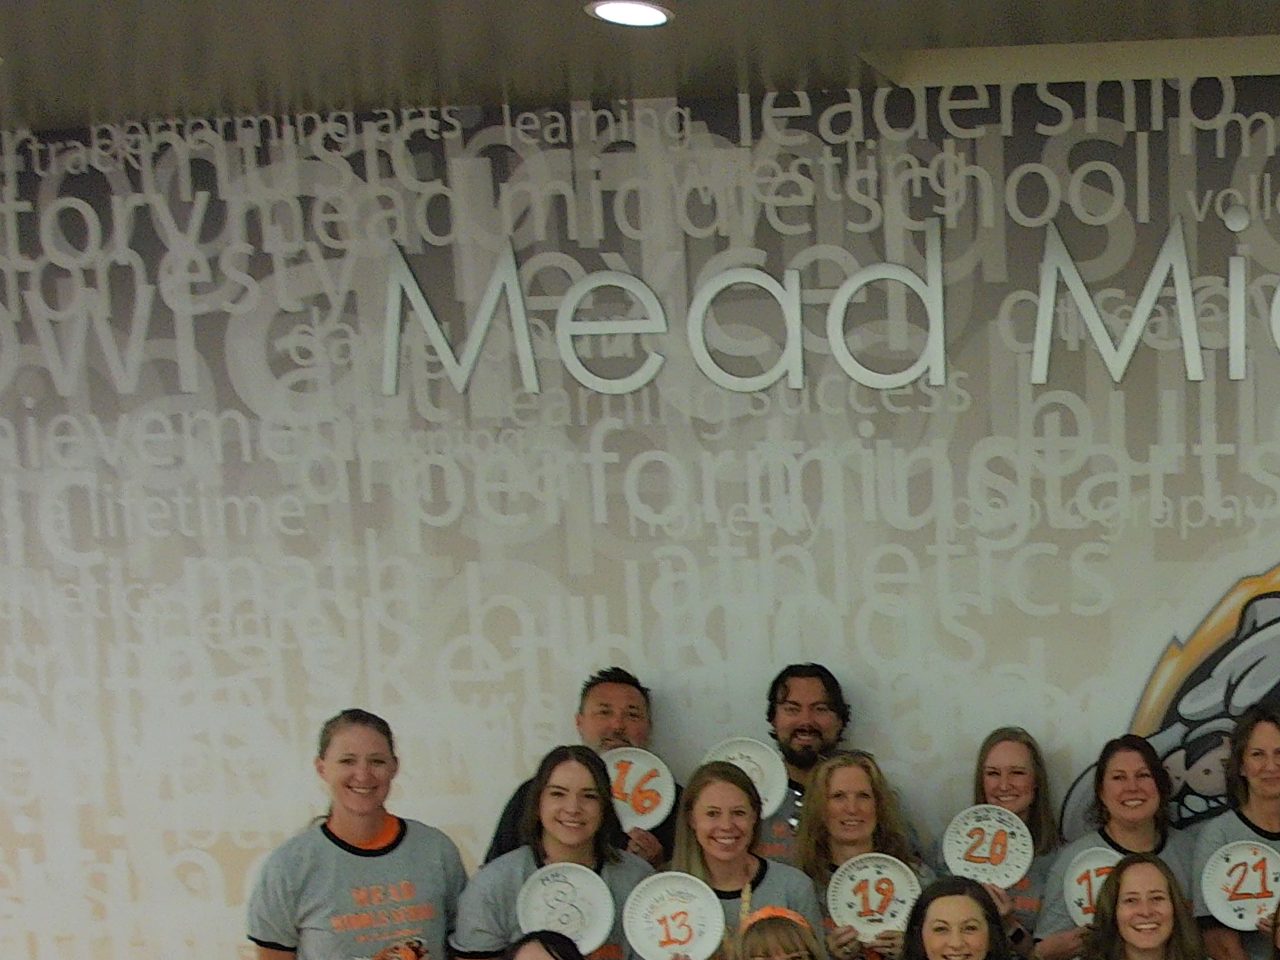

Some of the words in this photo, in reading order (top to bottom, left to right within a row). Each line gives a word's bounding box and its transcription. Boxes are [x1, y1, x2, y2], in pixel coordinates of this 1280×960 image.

[502, 98, 692, 151] learning
[739, 78, 1235, 156] leadership
[847, 130, 1150, 232] school
[382, 217, 946, 395] Mead
[612, 759, 662, 815] 16
[963, 827, 1008, 866] 20
[852, 878, 895, 918] 19
[1226, 857, 1274, 900] 21
[655, 911, 694, 949] 13
